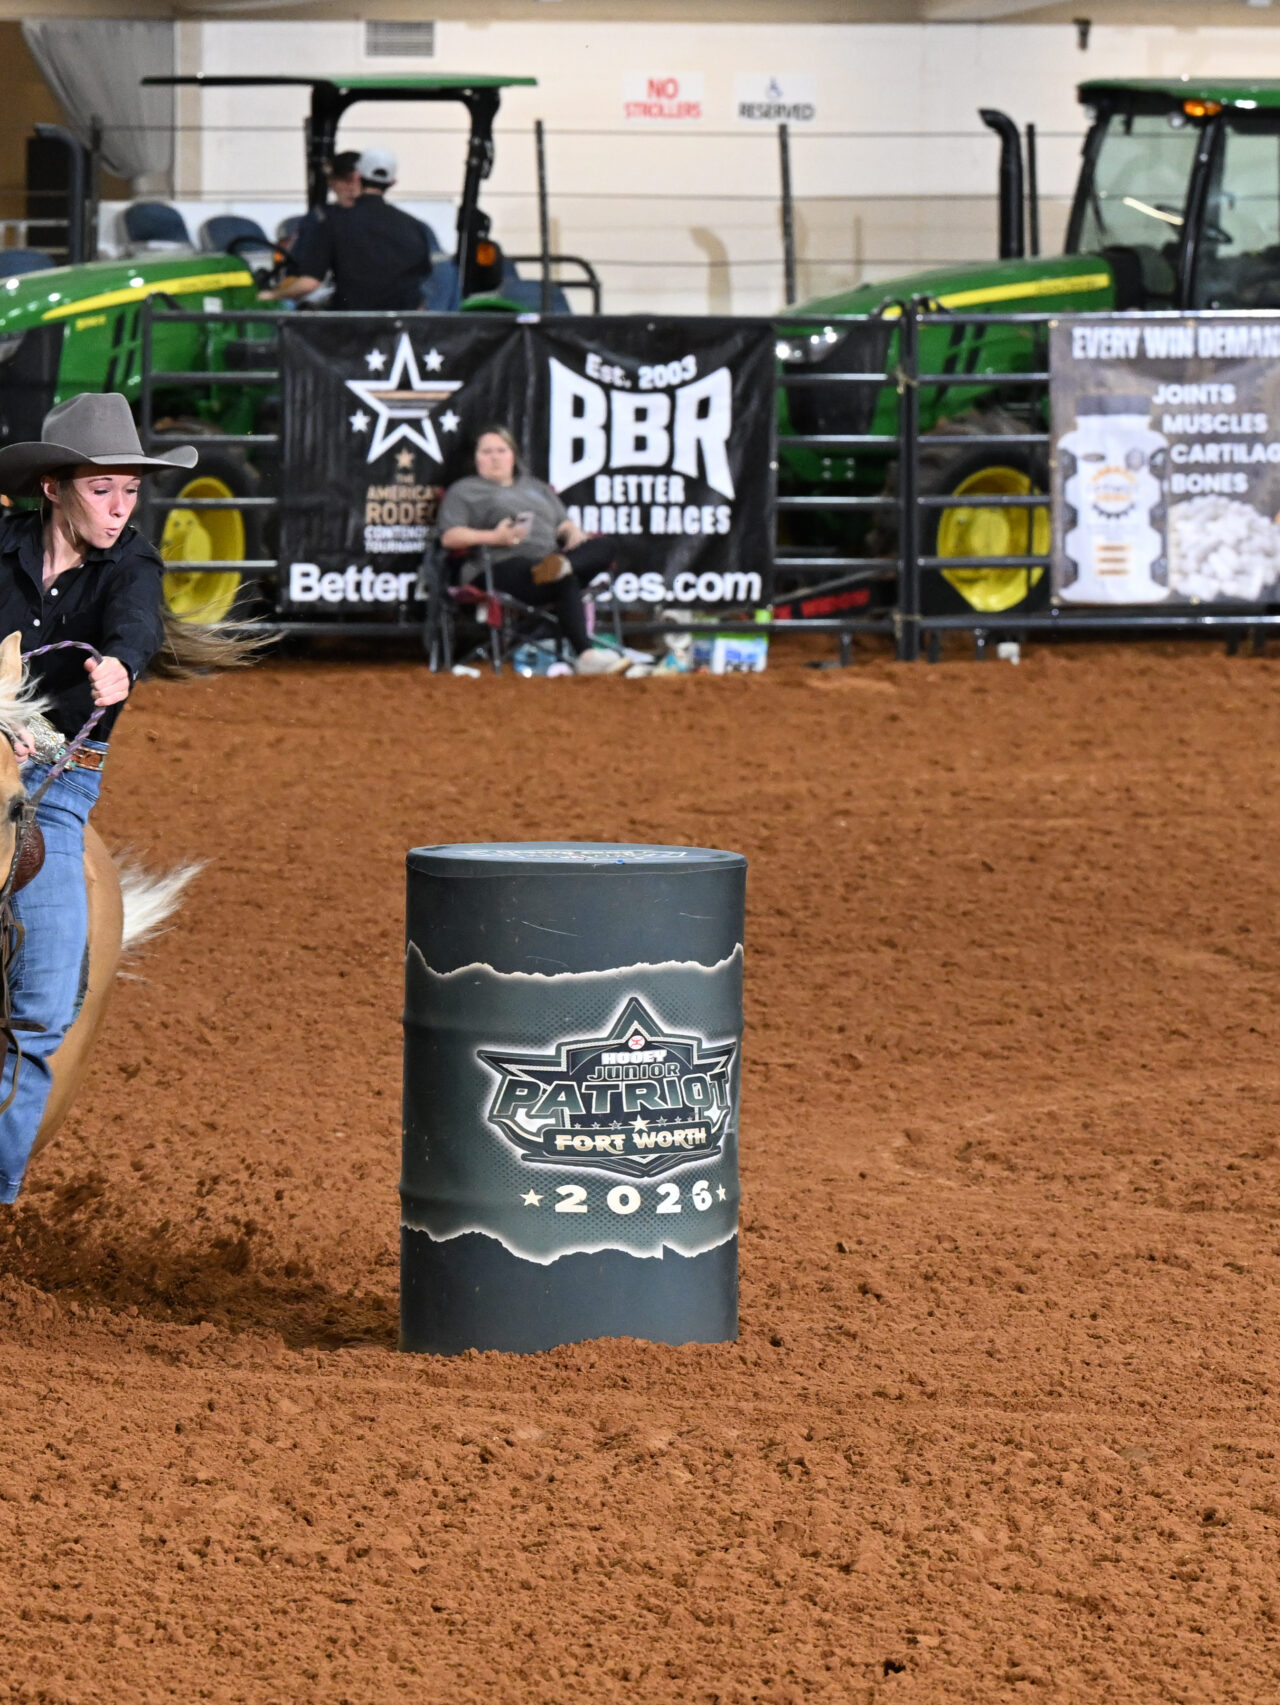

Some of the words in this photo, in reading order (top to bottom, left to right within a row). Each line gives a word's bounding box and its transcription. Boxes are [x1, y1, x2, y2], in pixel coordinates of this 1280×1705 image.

[647, 77, 680, 100] NO
[624, 101, 702, 120] STROLLERS
[738, 102, 815, 121] RESERVED
[1072, 325, 1140, 359] EVERY
[1143, 325, 1196, 359] WIN
[585, 352, 632, 388] Est.
[638, 354, 698, 390] 2003
[1152, 383, 1237, 405] JOINTS
[548, 356, 735, 501] BBR
[1161, 412, 1269, 434] MUSCLES
[366, 485, 436, 501] AMERICA
[594, 474, 686, 504] BETTER
[1171, 471, 1249, 494] BONES
[566, 505, 643, 534] ARREL
[649, 504, 732, 535] RACES
[601, 1049, 668, 1065] HOOEY
[587, 1062, 681, 1082] JUNIOR
[492, 1068, 730, 1117] PATRIOT
[554, 1133, 626, 1155] FORT
[632, 1126, 708, 1150] WORTH
[553, 1179, 714, 1215] 2026
